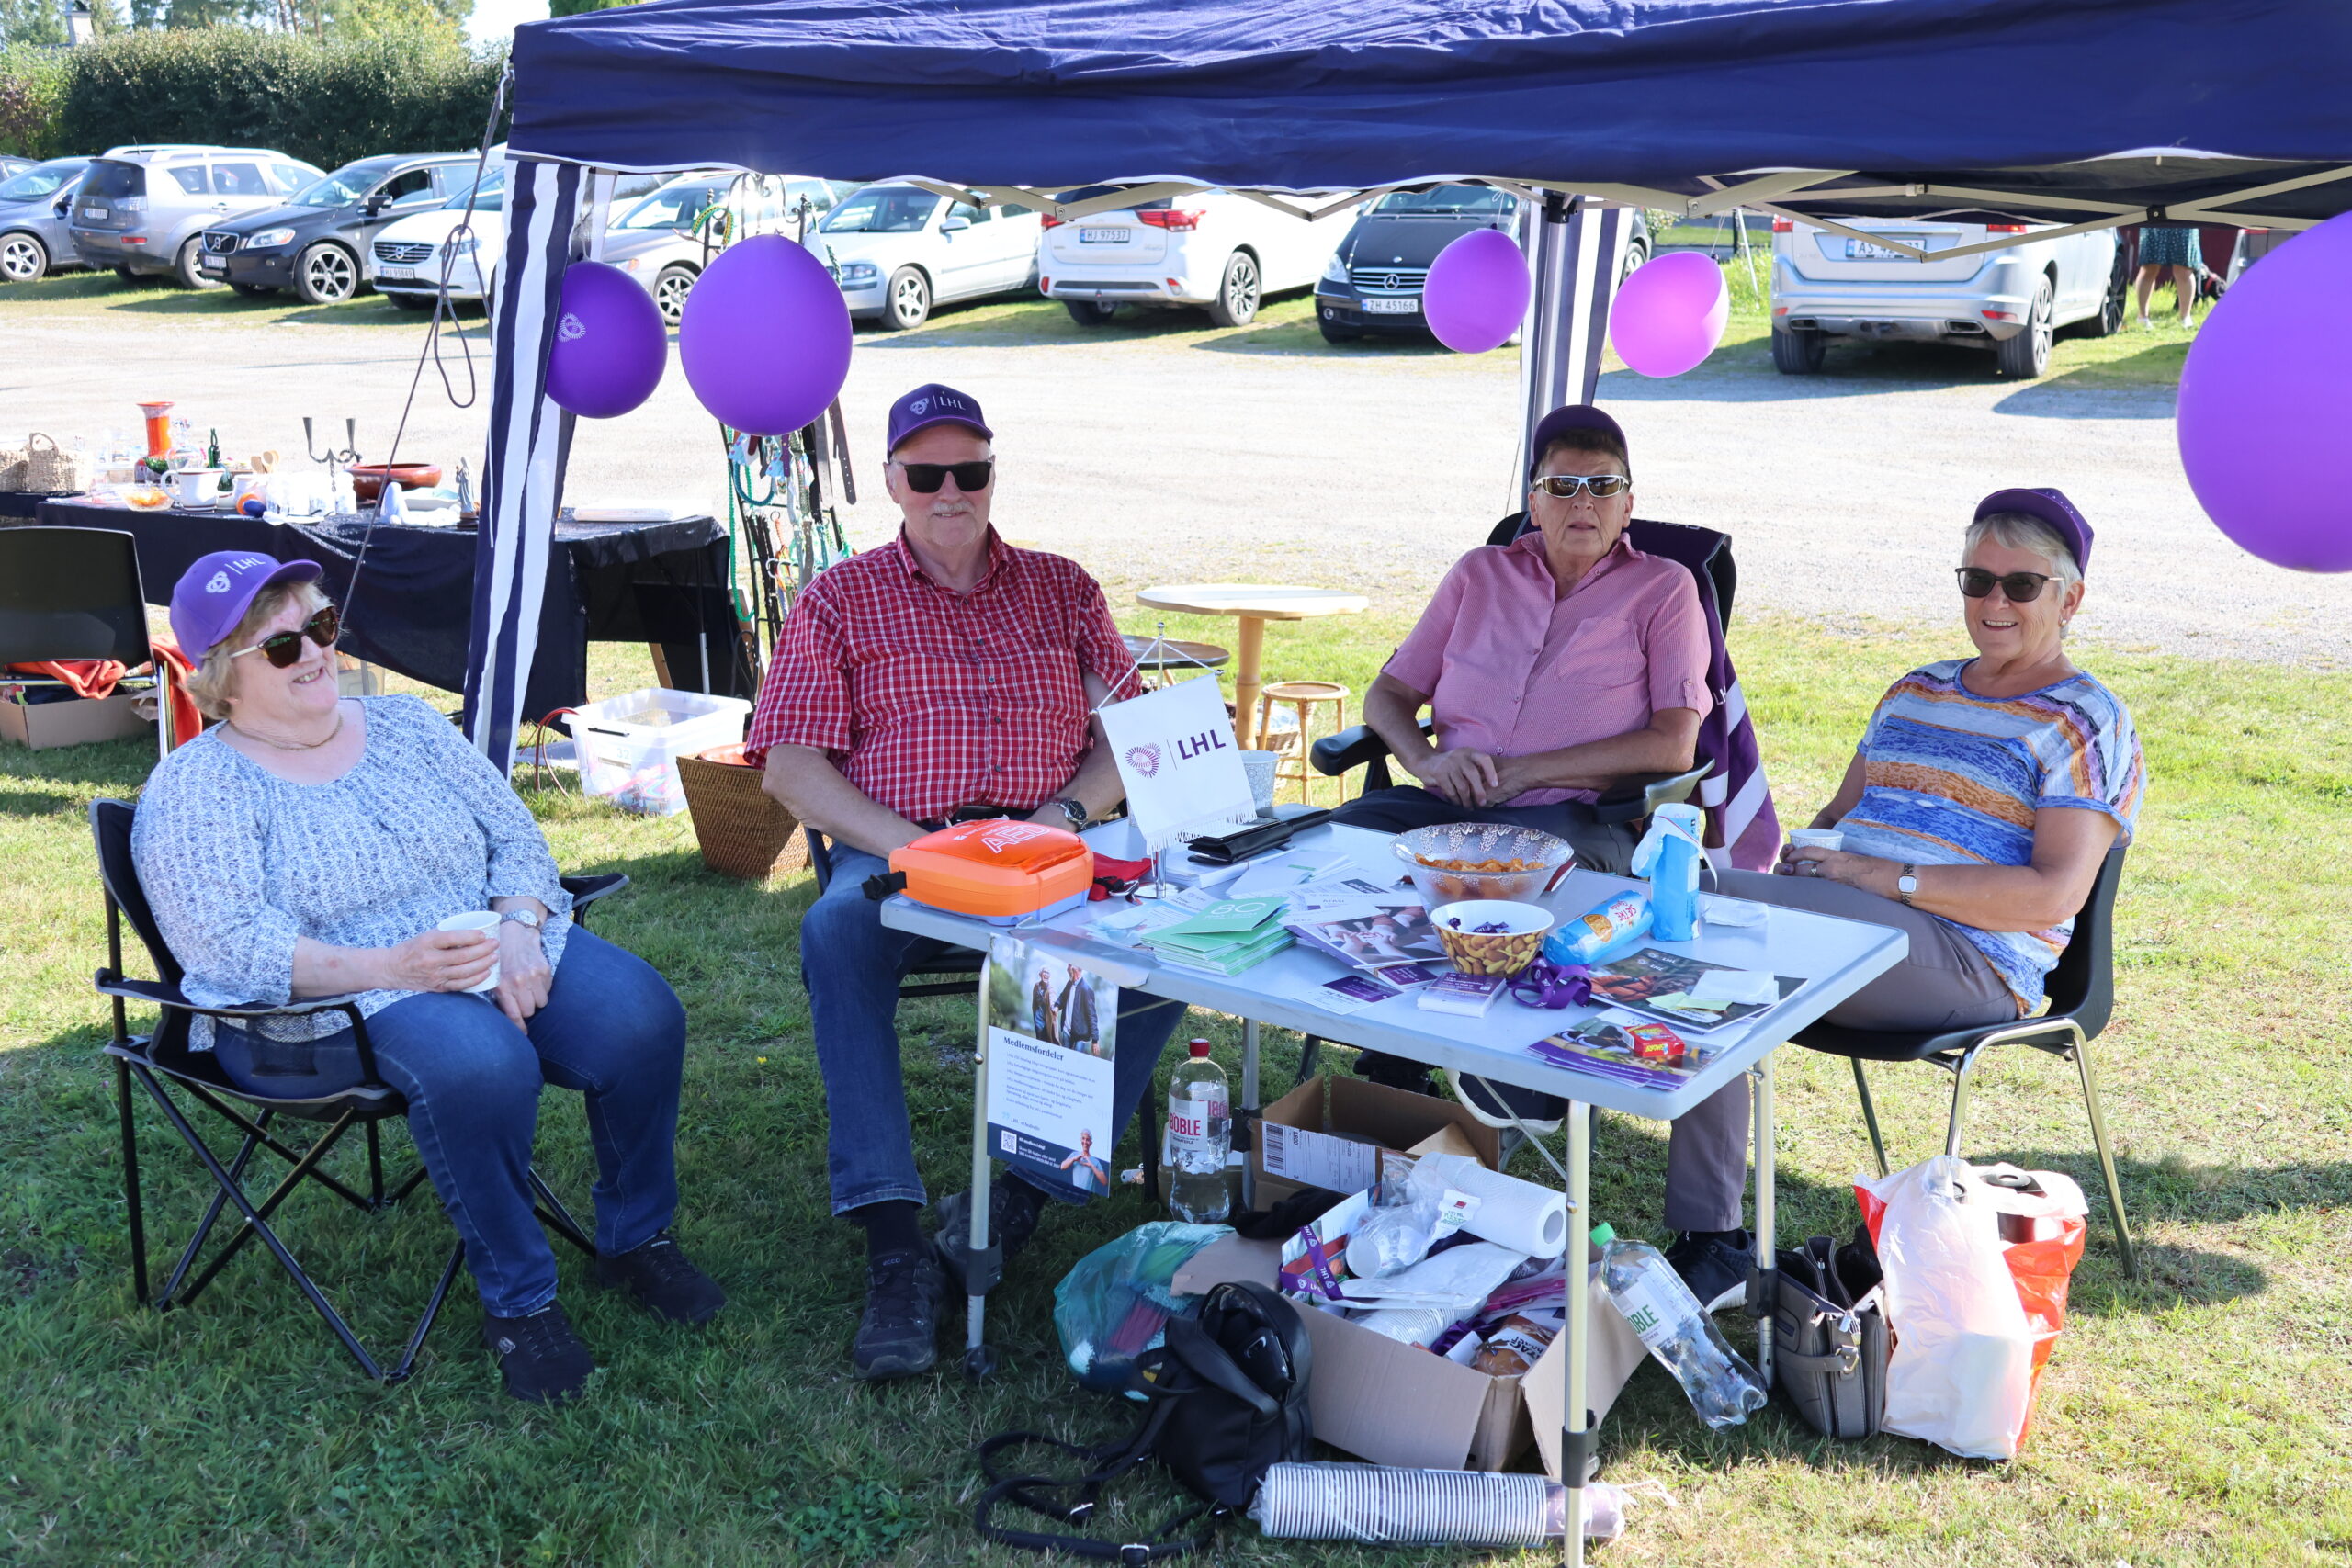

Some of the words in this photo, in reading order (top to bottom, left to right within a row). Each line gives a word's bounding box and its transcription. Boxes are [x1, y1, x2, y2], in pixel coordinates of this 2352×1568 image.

[1087, 231, 1098, 240] HJ
[1101, 231, 1126, 240] 97537
[1369, 300, 1382, 310] ZH
[1385, 300, 1416, 310] 45166
[939, 396, 967, 411] LHL
[232, 557, 266, 570] LHL
[1177, 729, 1227, 761] LHL
[980, 824, 1050, 854] AED
[1003, 1036, 1064, 1061] Medlemsfordeler
